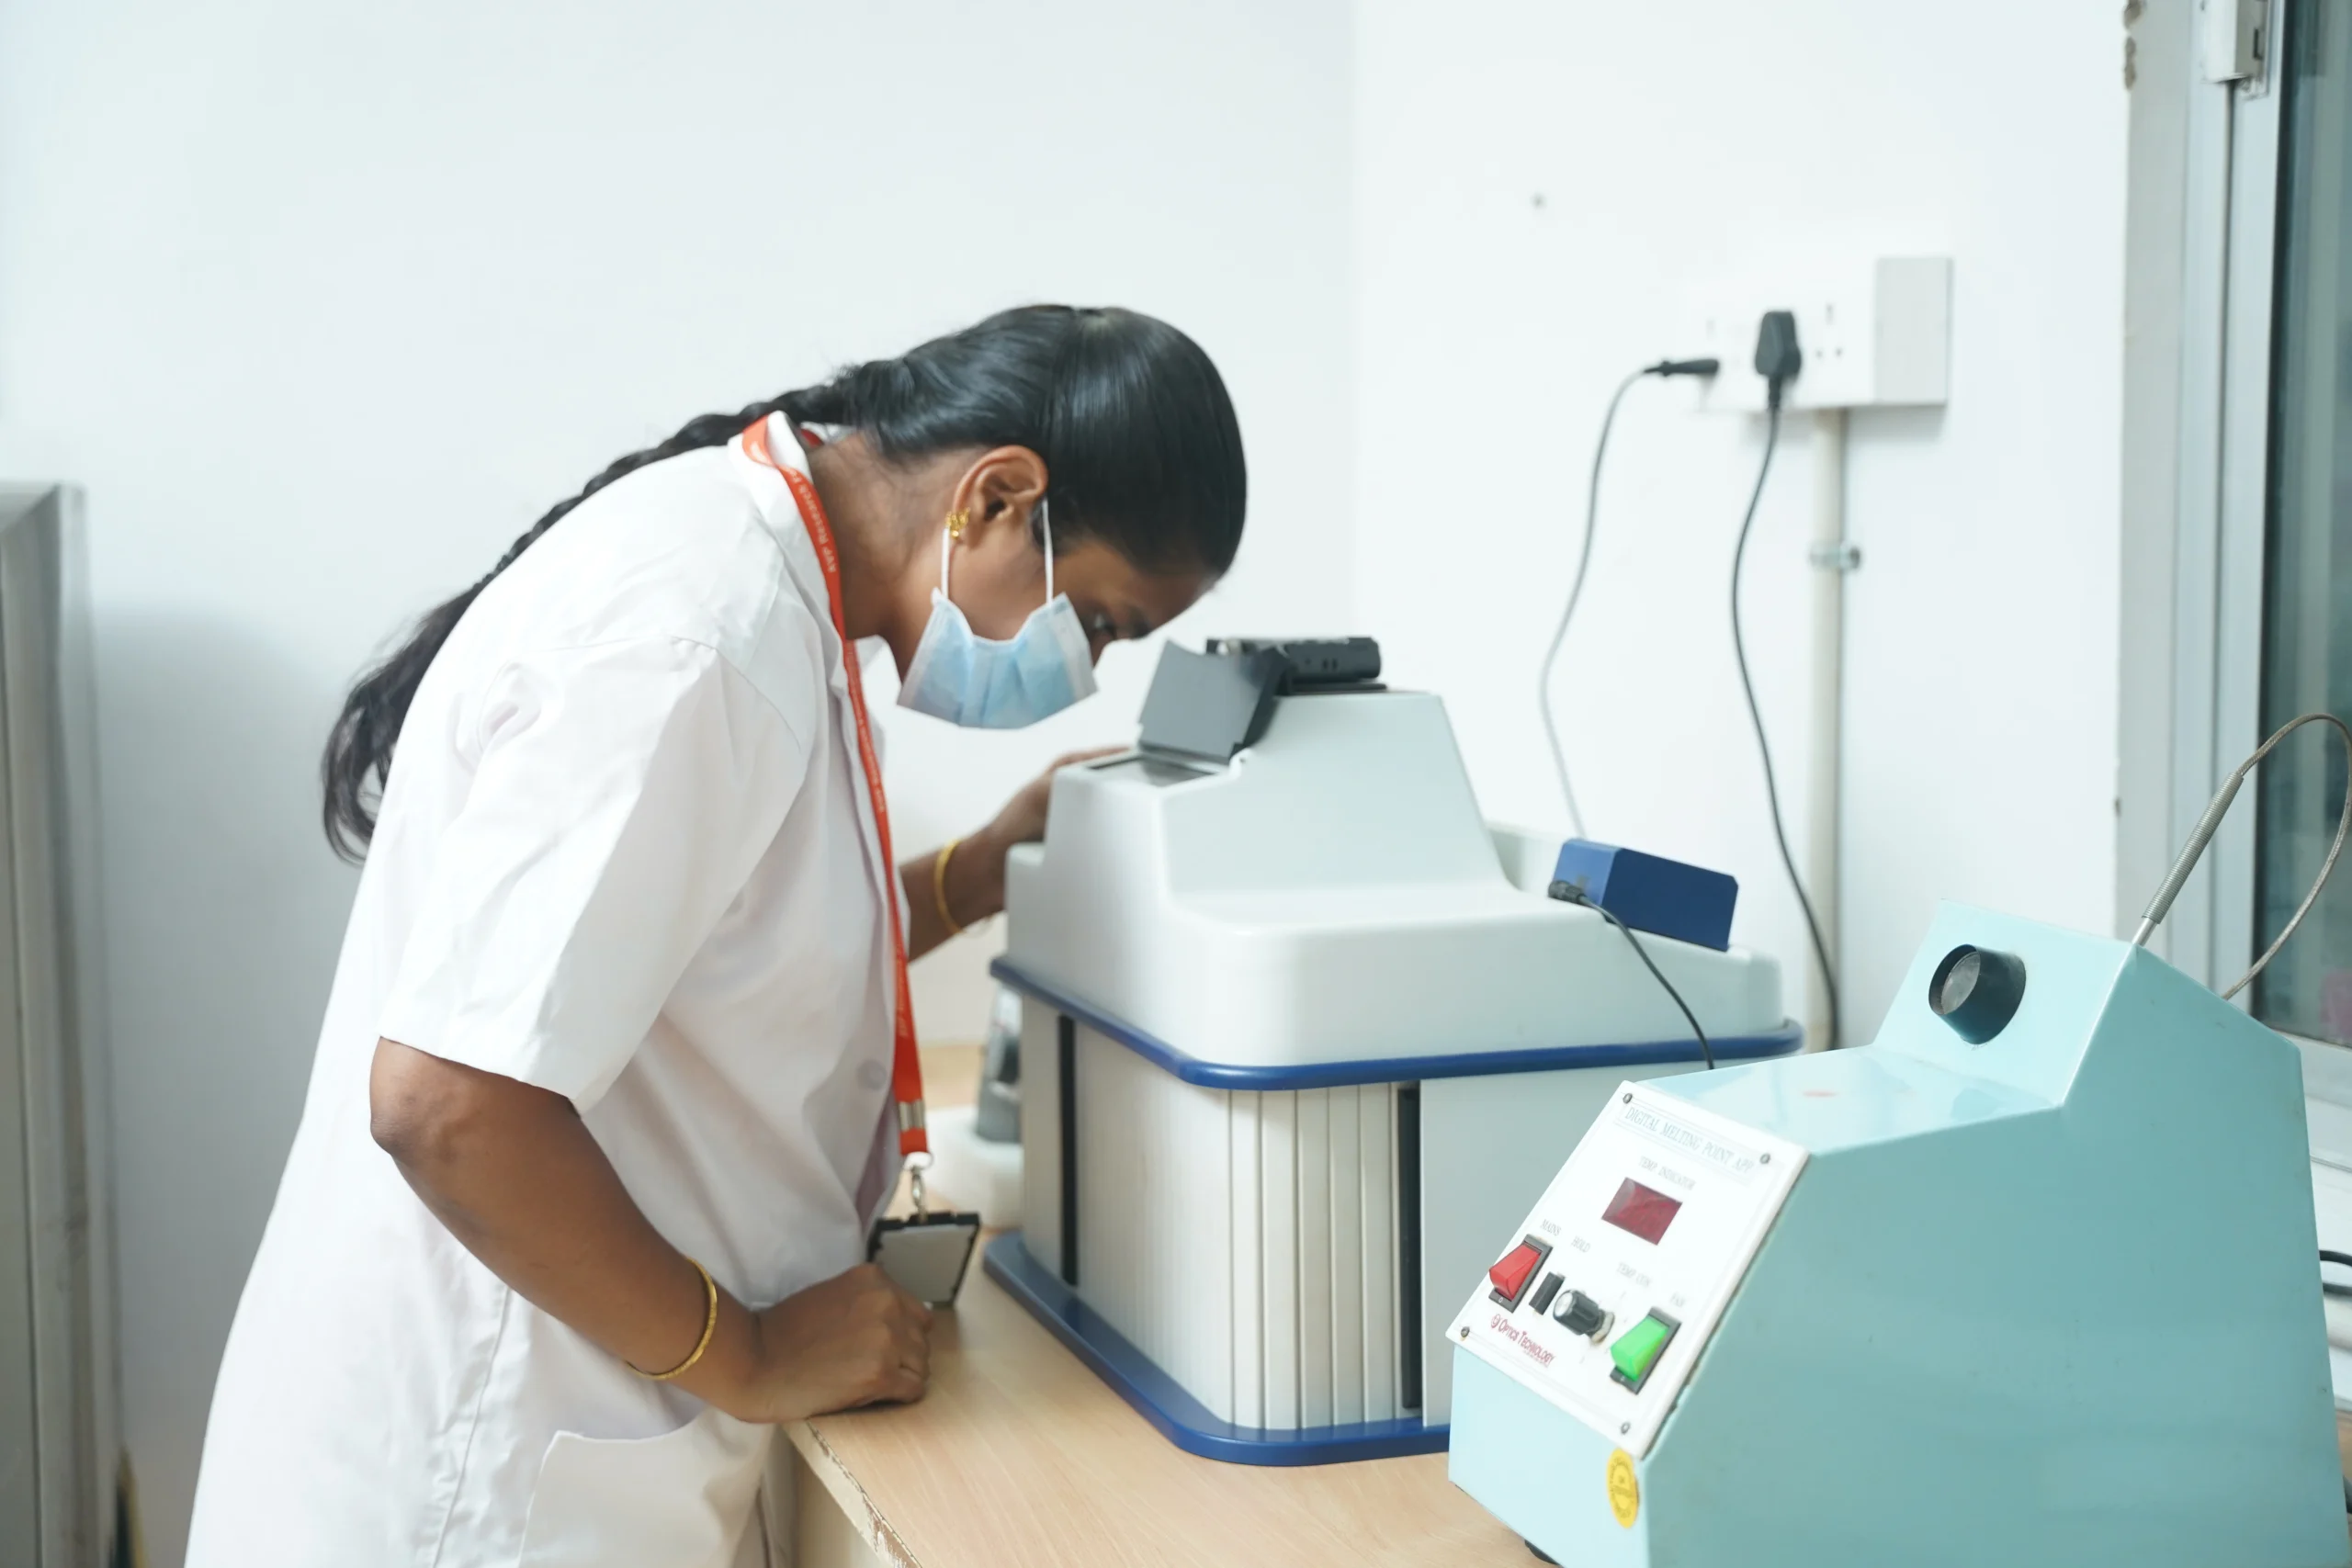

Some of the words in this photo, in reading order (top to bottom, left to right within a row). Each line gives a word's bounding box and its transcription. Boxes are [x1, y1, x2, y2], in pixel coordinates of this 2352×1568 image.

[1624, 1106, 1660, 1132] DIGITAL
[1660, 1122, 1703, 1150] MELTING
[1702, 1141, 1735, 1165] POINT
[1658, 1166, 1697, 1190] INDICATOR
[1540, 1218, 1562, 1236] MAINS
[1570, 1235, 1591, 1253] HOLD
